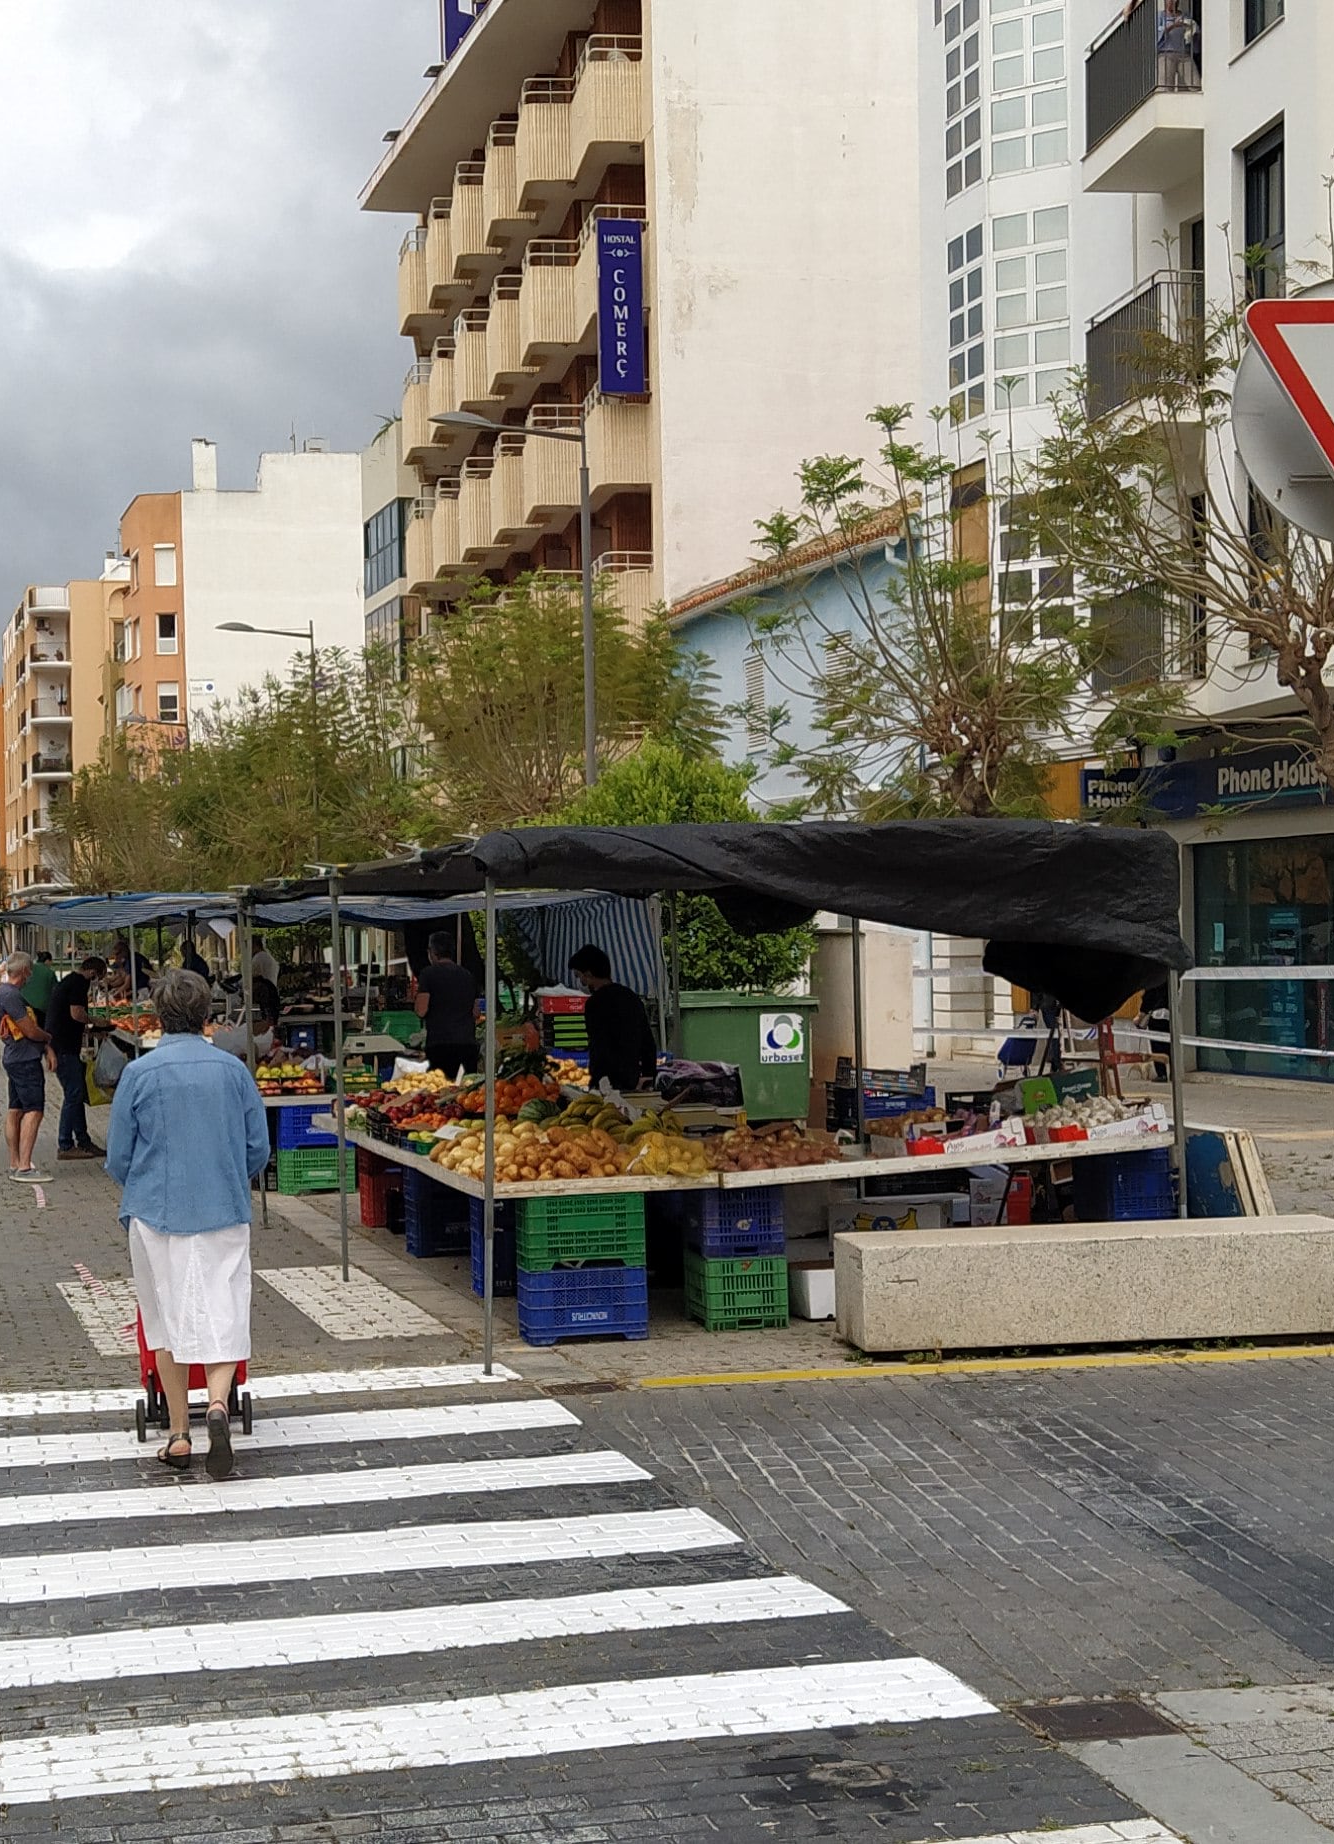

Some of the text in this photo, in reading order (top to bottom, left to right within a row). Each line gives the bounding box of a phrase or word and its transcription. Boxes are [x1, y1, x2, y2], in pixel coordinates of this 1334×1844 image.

[603, 234, 637, 244] HOSTAL
[613, 269, 629, 378] COMERÇ
[1217, 759, 1327, 795] Phone Hous
